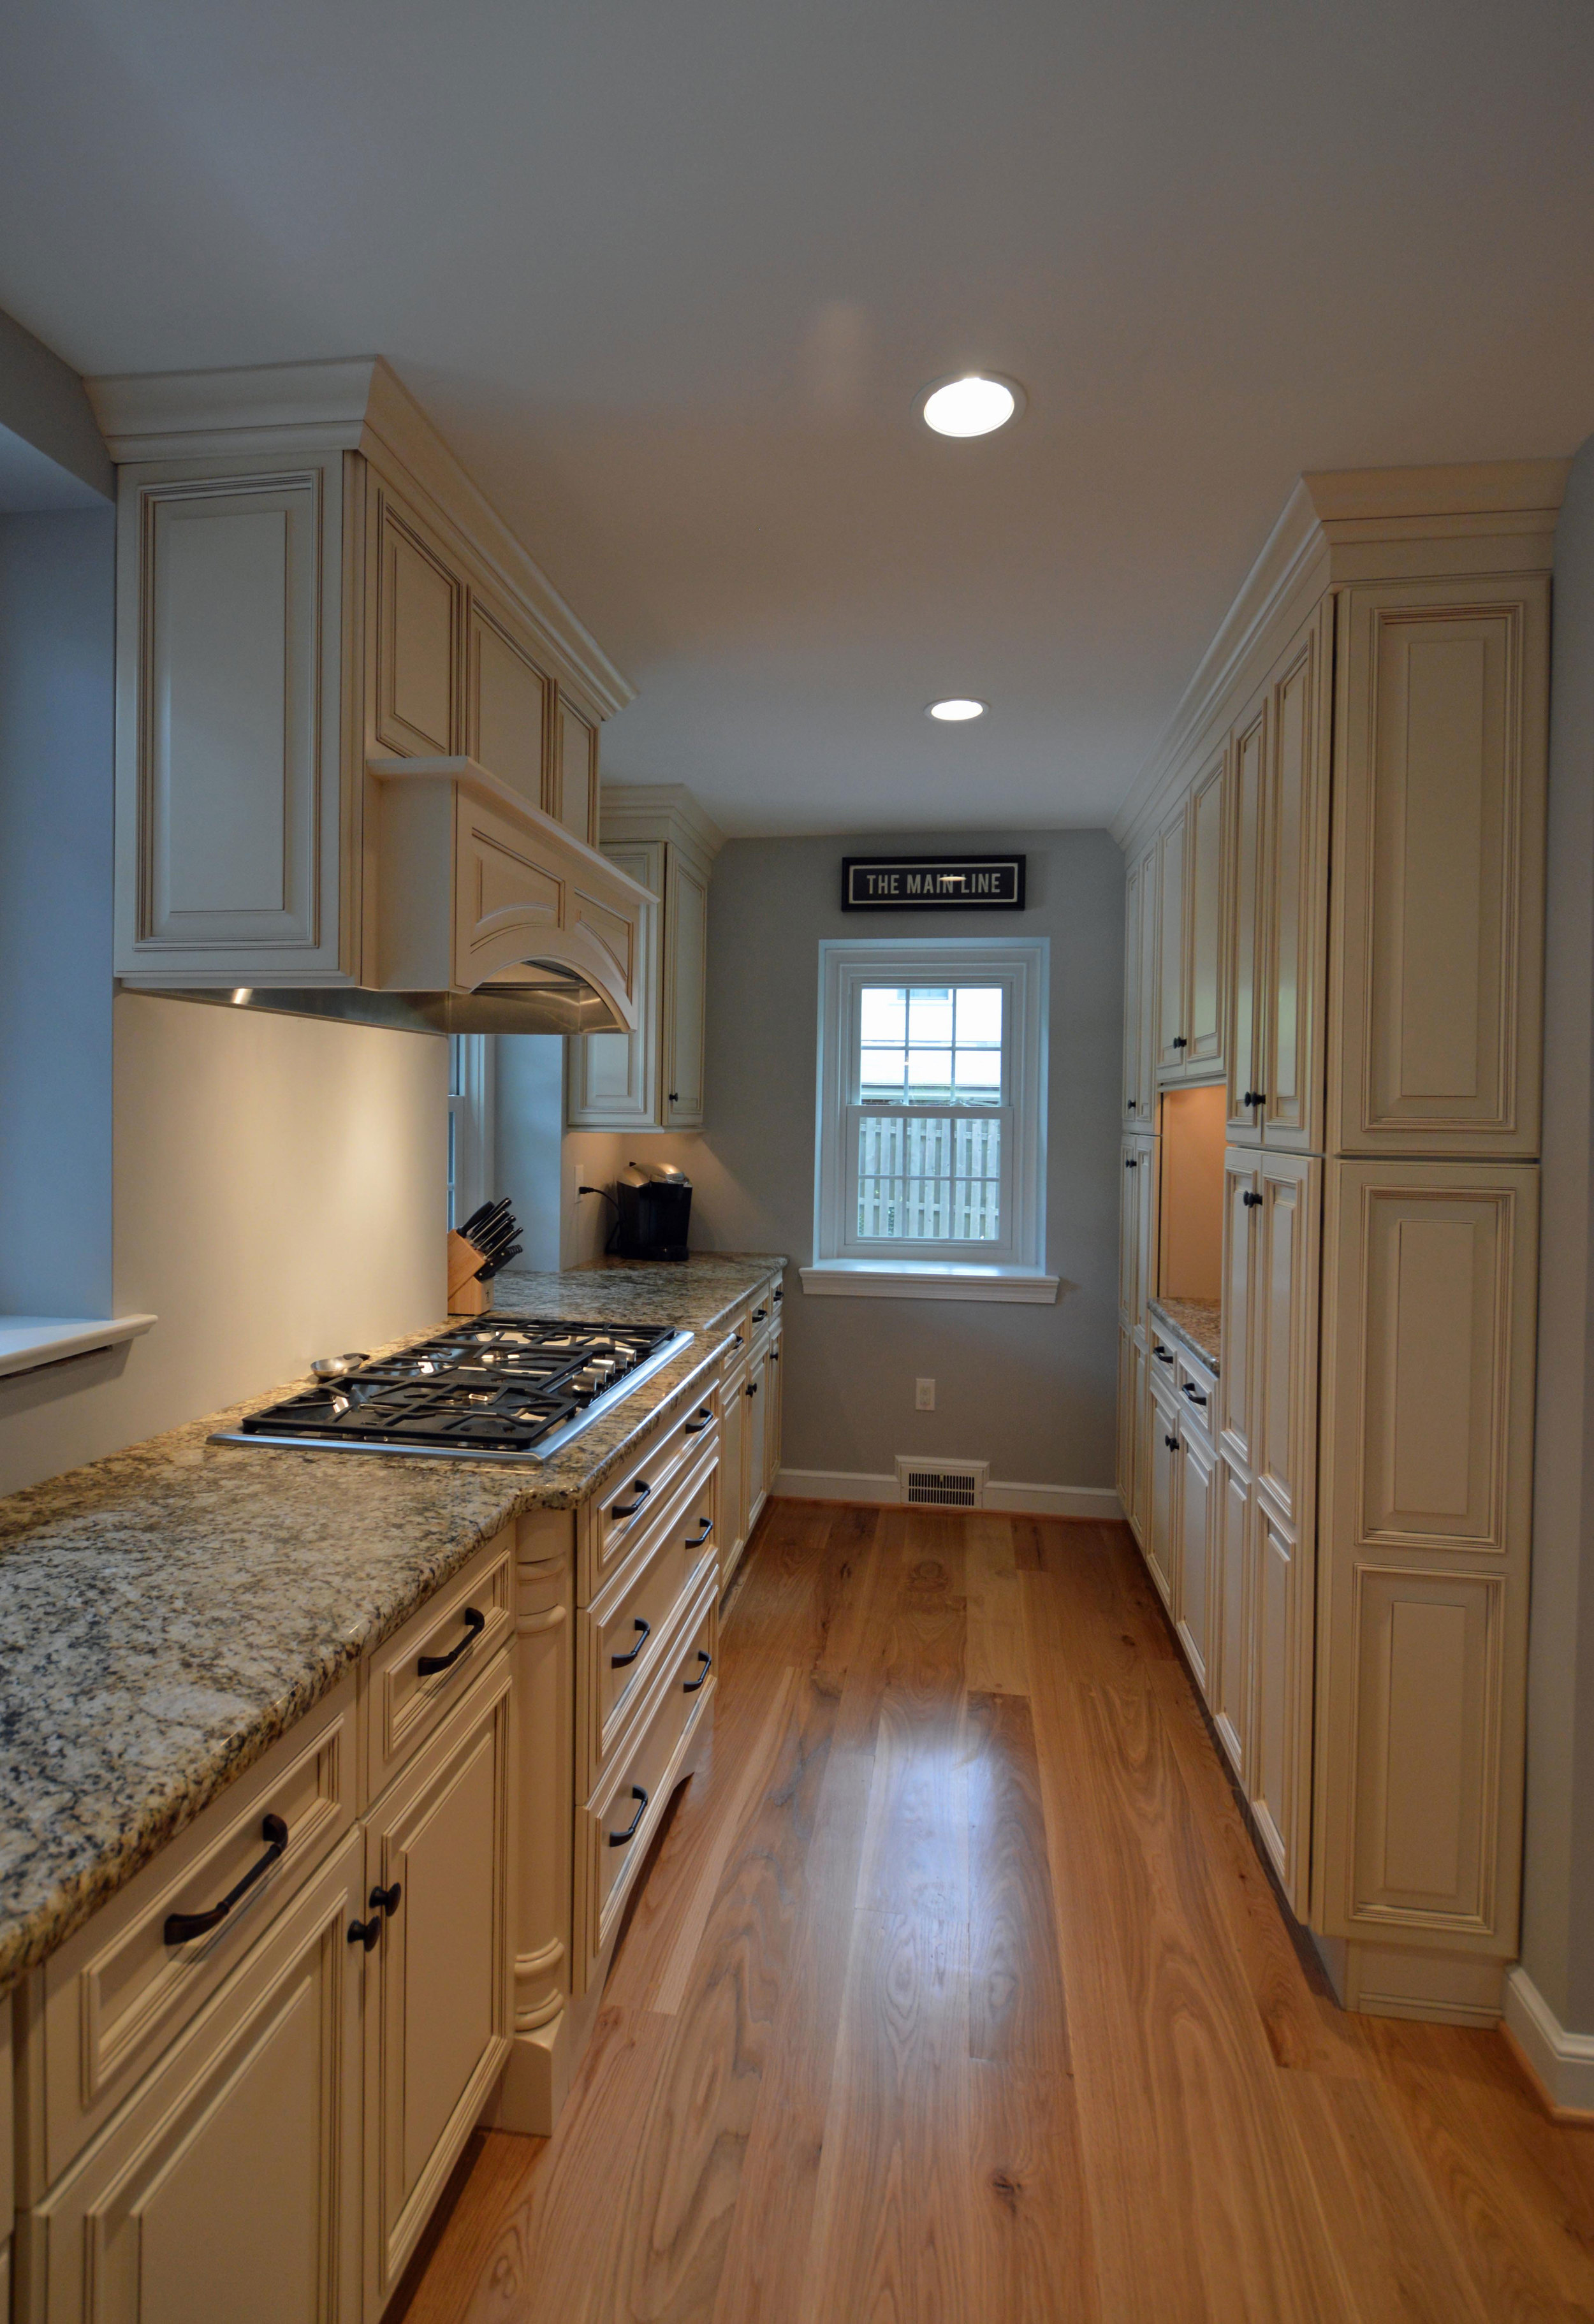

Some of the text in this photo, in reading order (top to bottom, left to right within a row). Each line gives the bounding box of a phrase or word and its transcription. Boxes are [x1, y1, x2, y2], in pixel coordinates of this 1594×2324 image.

[866, 873, 1001, 894] THE MAIN LINE
